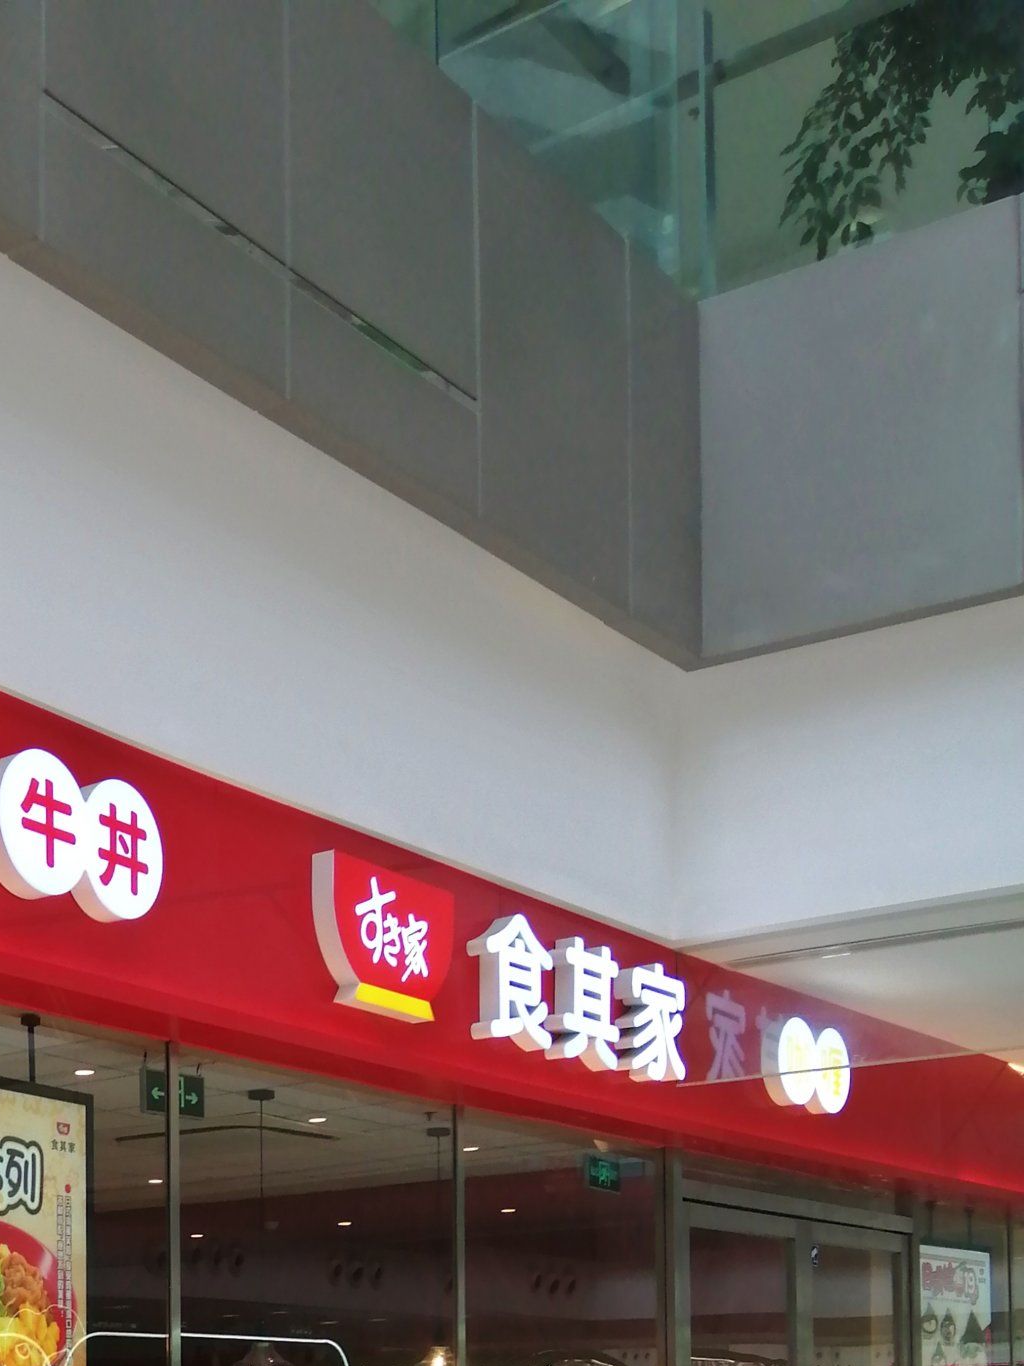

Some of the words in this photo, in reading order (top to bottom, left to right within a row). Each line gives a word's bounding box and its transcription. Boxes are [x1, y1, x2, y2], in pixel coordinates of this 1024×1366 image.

[20, 777, 149, 896] 牛丼
[355, 876, 429, 982] すき家
[480, 912, 687, 1083] 食其家
